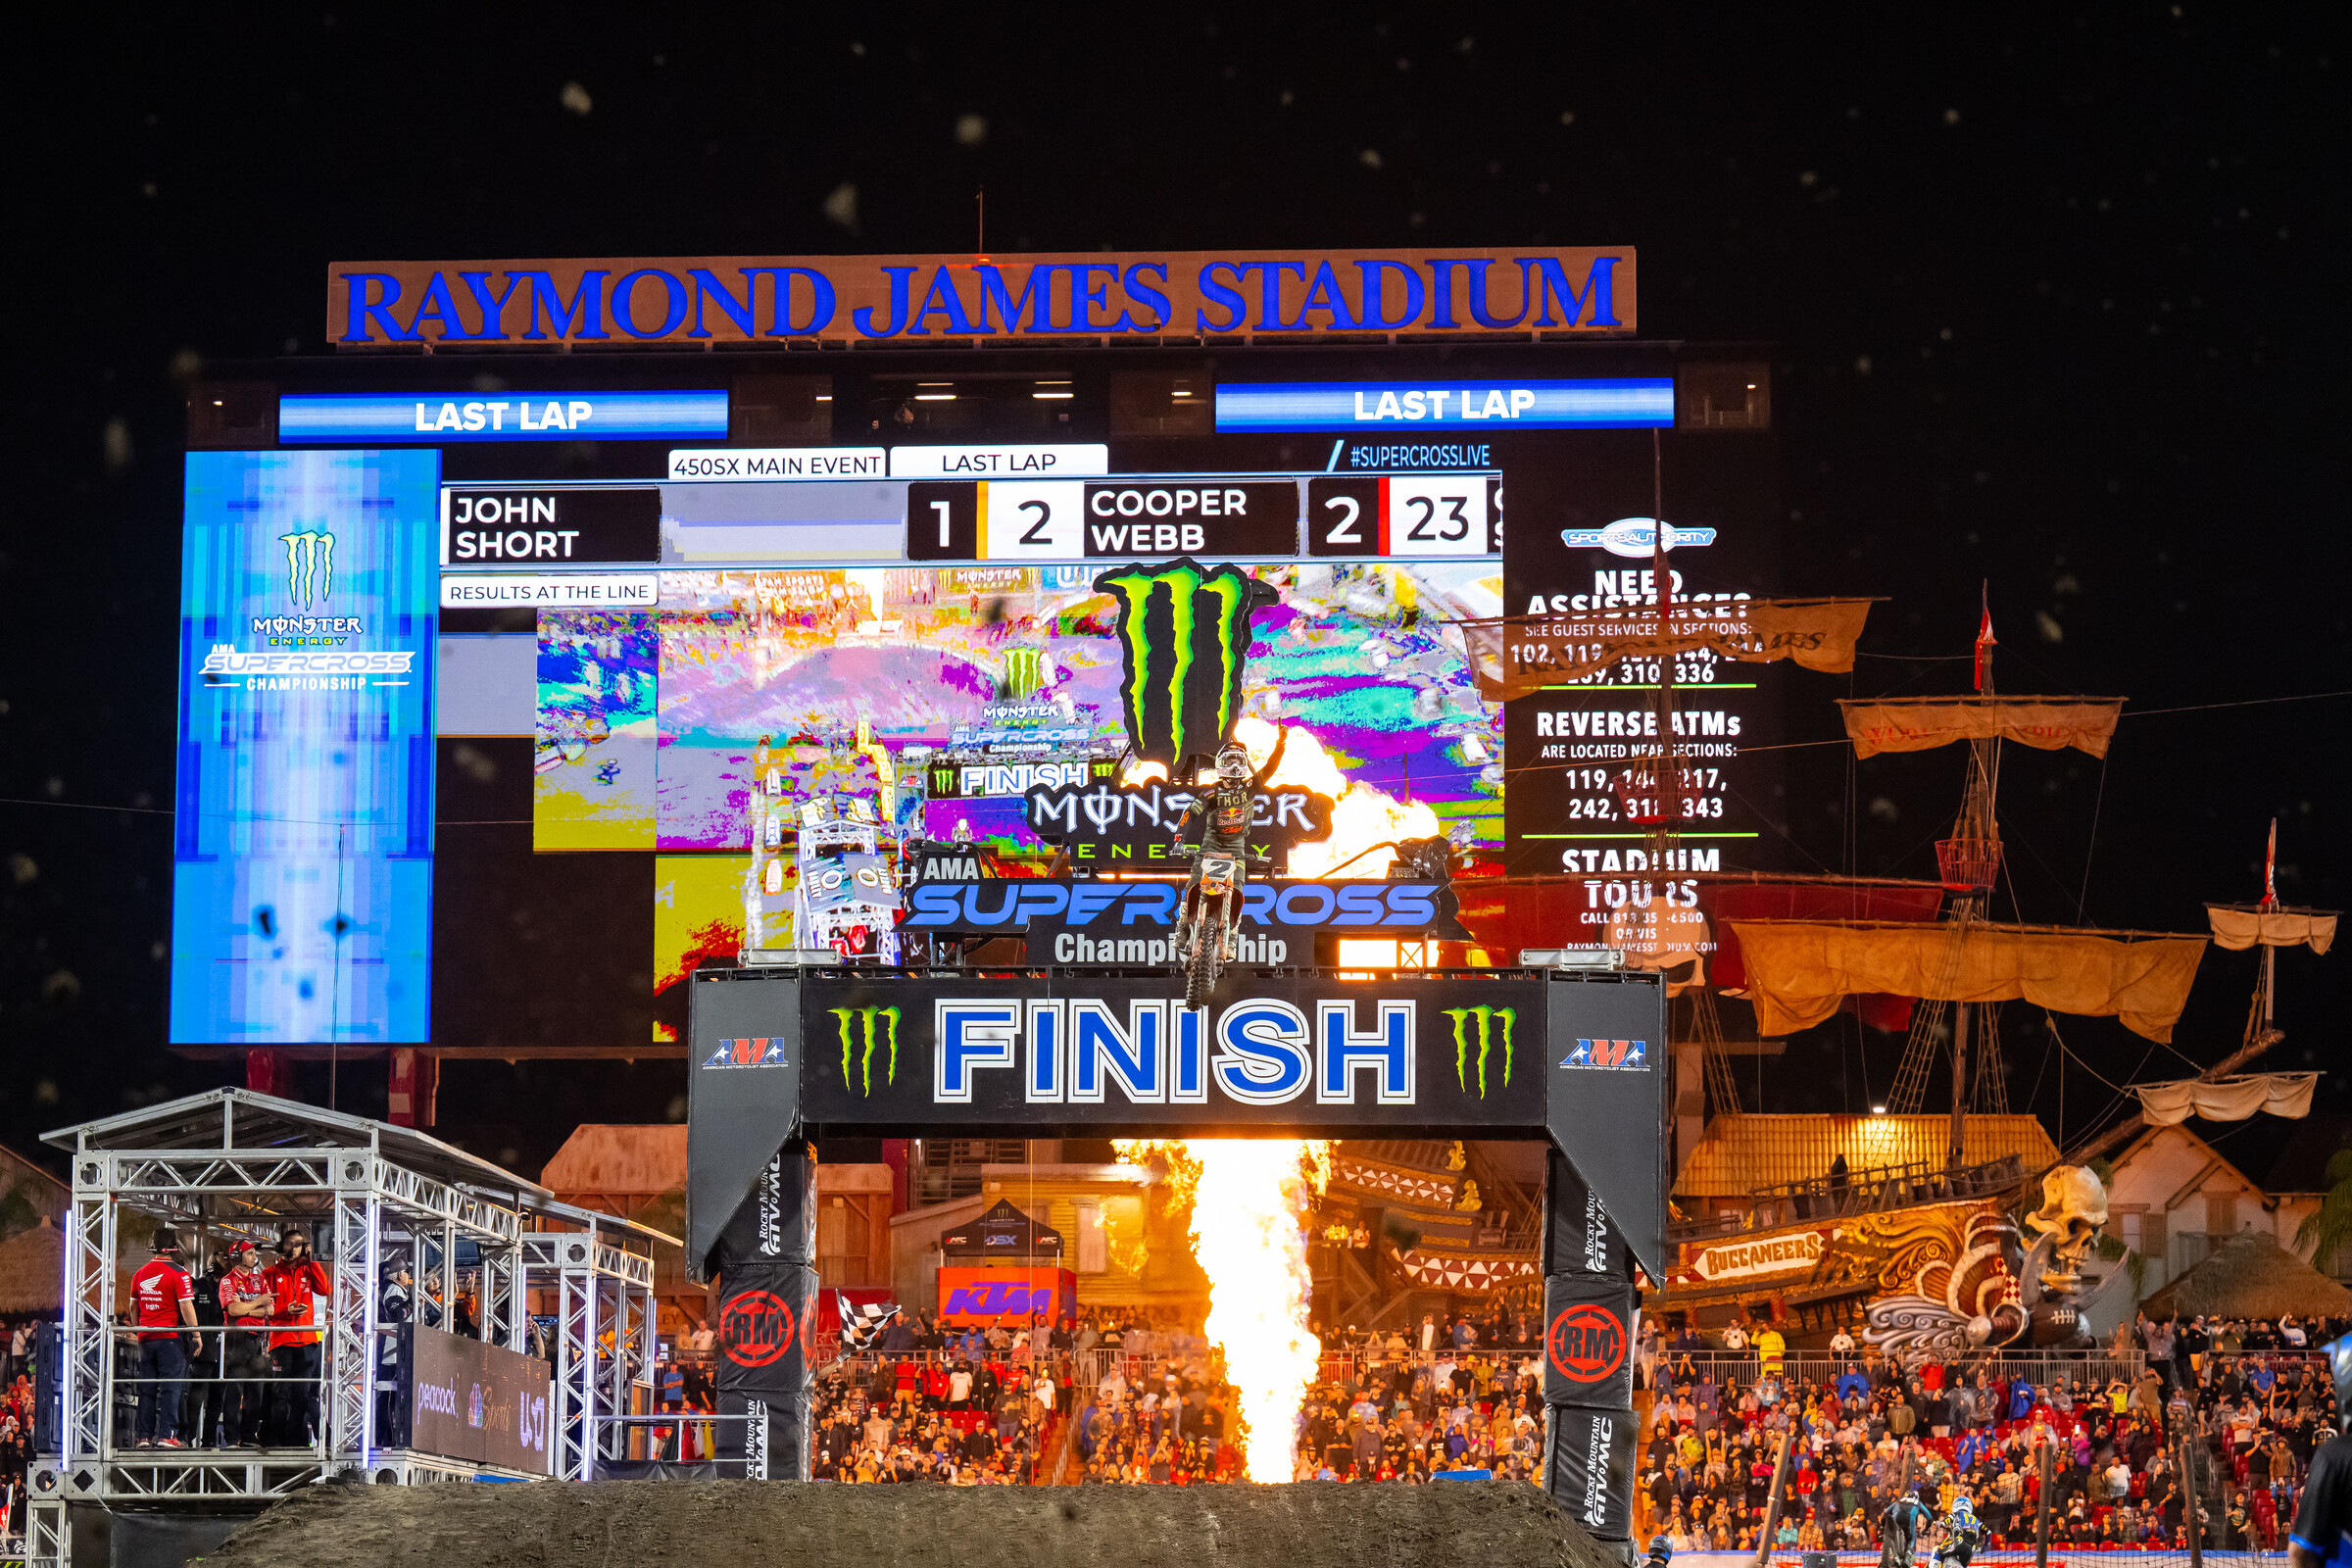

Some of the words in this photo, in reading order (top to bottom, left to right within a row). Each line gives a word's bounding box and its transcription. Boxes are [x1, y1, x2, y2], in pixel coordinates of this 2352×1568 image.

[340, 268, 836, 342] RAYMOND
[853, 262, 1172, 338] JAMES
[1197, 256, 1622, 332] STADIUM
[415, 402, 509, 431] LAST
[519, 401, 593, 429] LAP
[1353, 391, 1452, 420] LAST
[1461, 389, 1536, 418] LAP
[674, 458, 739, 476] 450SX
[747, 458, 802, 475] MAIN
[810, 457, 880, 474] EVENT
[942, 453, 1002, 472] LAST
[1011, 453, 1056, 471] LAP
[1350, 444, 1491, 468] #SUPERCROSSLIVE
[456, 497, 556, 524] JOHN
[1091, 489, 1247, 517] COOPER
[930, 502, 951, 547] 1
[1018, 500, 1053, 545] 2
[1326, 496, 1362, 544] 2
[1405, 496, 1469, 541] 23
[456, 530, 579, 559] SHORT
[1091, 524, 1205, 552] WEBB
[450, 585, 530, 600] RESULTS
[536, 585, 557, 600] AT
[562, 584, 602, 599] THE
[608, 584, 649, 598] LINE
[1595, 570, 1683, 595] NEED
[253, 615, 363, 636] MONSTER
[1525, 624, 1548, 637] SEE
[1553, 623, 1594, 636] GUEST
[1598, 622, 1658, 636] SERVICES
[212, 644, 236, 654] AMA
[270, 637, 348, 646] ENERGY
[204, 654, 410, 672] SUPERCROSS
[1675, 663, 1715, 684] 336
[247, 677, 367, 691] CHAMPIONSHIP
[983, 705, 1059, 719] MONSTER
[1537, 711, 1657, 736] REVERSE
[1671, 711, 1740, 735] ATMs
[989, 744, 1053, 754] Championship
[1542, 745, 1566, 758] ARE
[1570, 744, 1626, 758] LOCATED
[1673, 743, 1738, 757] SECTIONS:
[960, 761, 1089, 796] FINISH
[1566, 768, 1614, 792] 119,
[1033, 785, 1316, 835] MONSER
[1217, 791, 1248, 808] THOR
[1569, 799, 1618, 821] 242,
[1682, 798, 1723, 817] 343
[1079, 843, 1271, 858] ENEY
[1562, 849, 1719, 873] STADIUM
[923, 858, 979, 880] AMA
[1206, 860, 1232, 878] 2
[908, 883, 1438, 925] SUPERROSS
[1581, 912, 1609, 924] CALL
[1054, 931, 1288, 965] Champihip
[702, 1038, 789, 1066] AMA
[933, 998, 1417, 1106] FINISH
[1559, 1039, 1651, 1067] AMA
[760, 1169, 768, 1204] MOUN
[760, 1205, 769, 1239] ROCKY
[1585, 1221, 1595, 1255] ROCKY
[1705, 1233, 1820, 1276] BUCCANEERS
[944, 1282, 1052, 1314] KTM
[732, 1313, 779, 1345] RM
[1562, 1325, 1612, 1361] RM
[417, 1377, 456, 1425] peacock
[746, 1399, 757, 1455] MOUNAIN
[1587, 1415, 1601, 1468] MOUNTAIN
[1584, 1475, 1595, 1509] ROCKY
